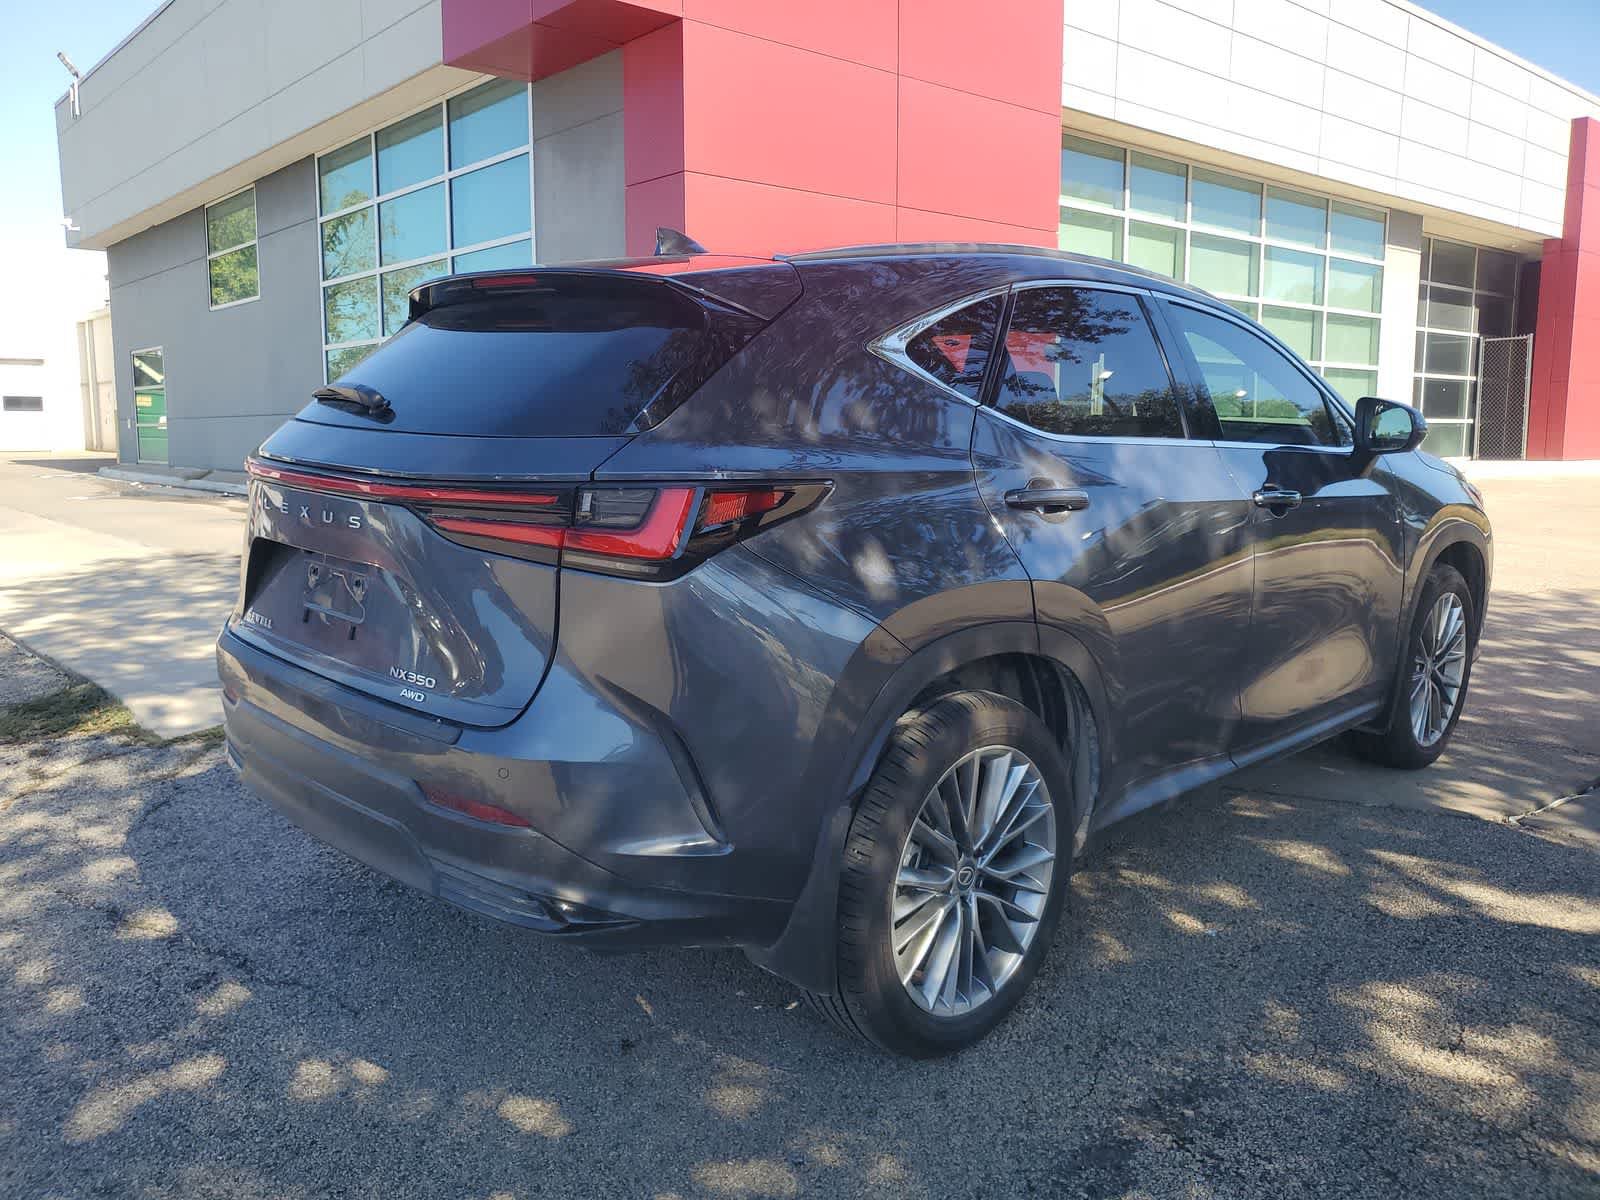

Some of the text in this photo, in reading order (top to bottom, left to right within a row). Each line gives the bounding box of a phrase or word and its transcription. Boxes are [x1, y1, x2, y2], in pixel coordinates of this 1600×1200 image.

[264, 498, 361, 529] LEXUS
[390, 666, 436, 689] NX350
[400, 688, 425, 702] AWD
